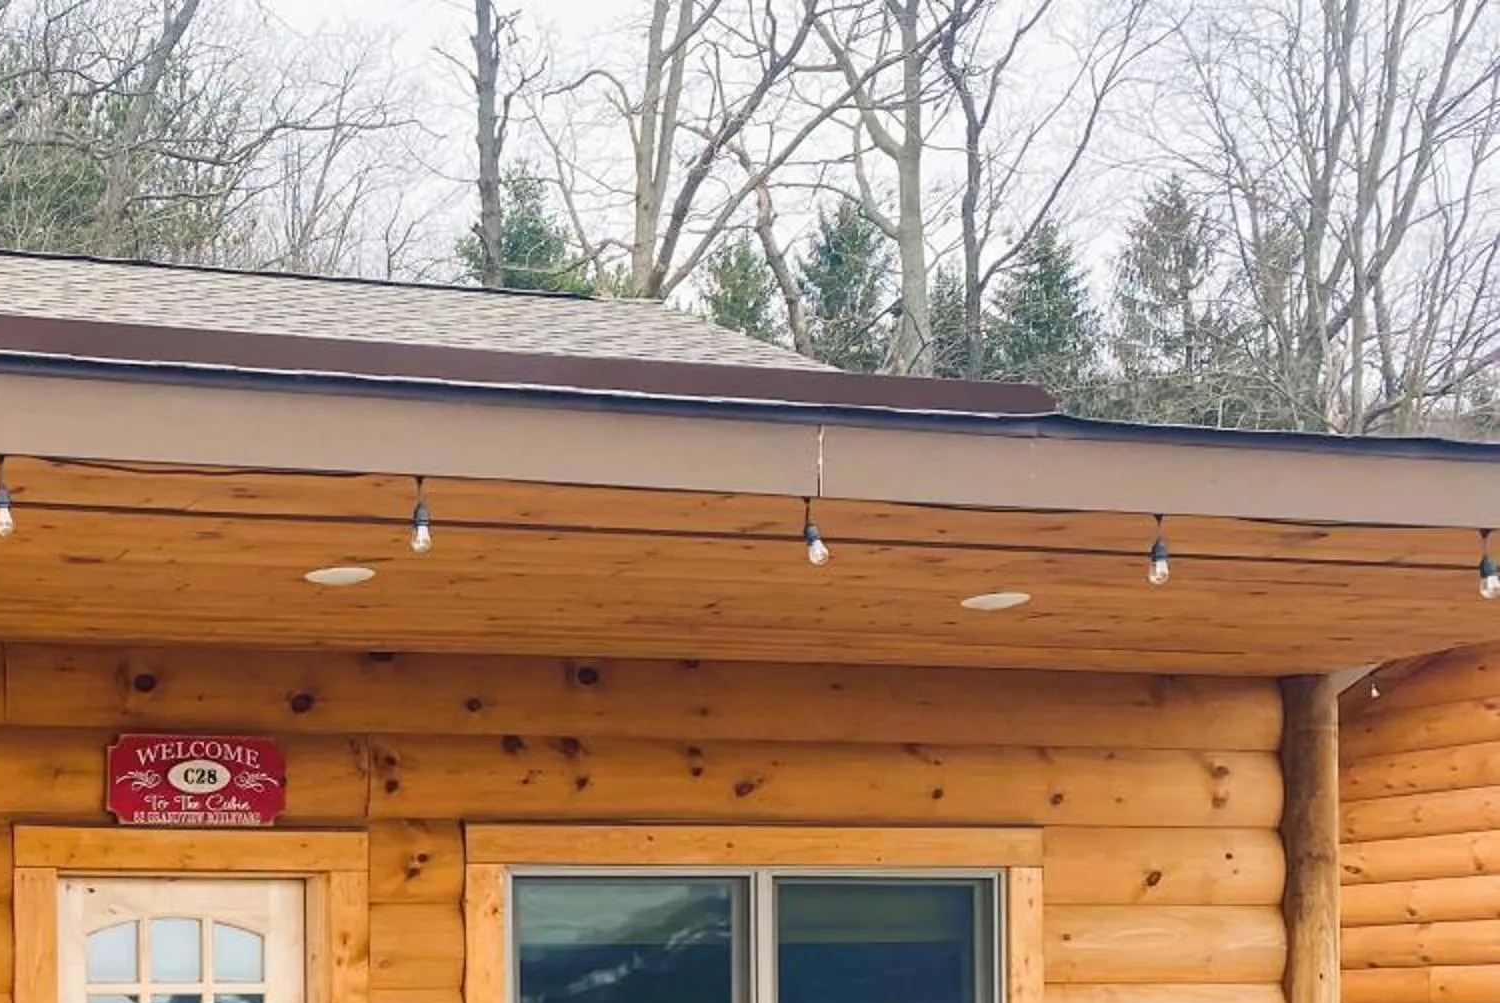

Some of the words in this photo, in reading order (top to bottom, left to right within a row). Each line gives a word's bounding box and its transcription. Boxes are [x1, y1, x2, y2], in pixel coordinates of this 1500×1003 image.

[136, 741, 261, 769] WELCOME
[183, 768, 218, 785] C28
[144, 794, 169, 811] To
[175, 794, 201, 811] The
[205, 794, 250, 811] Cabin
